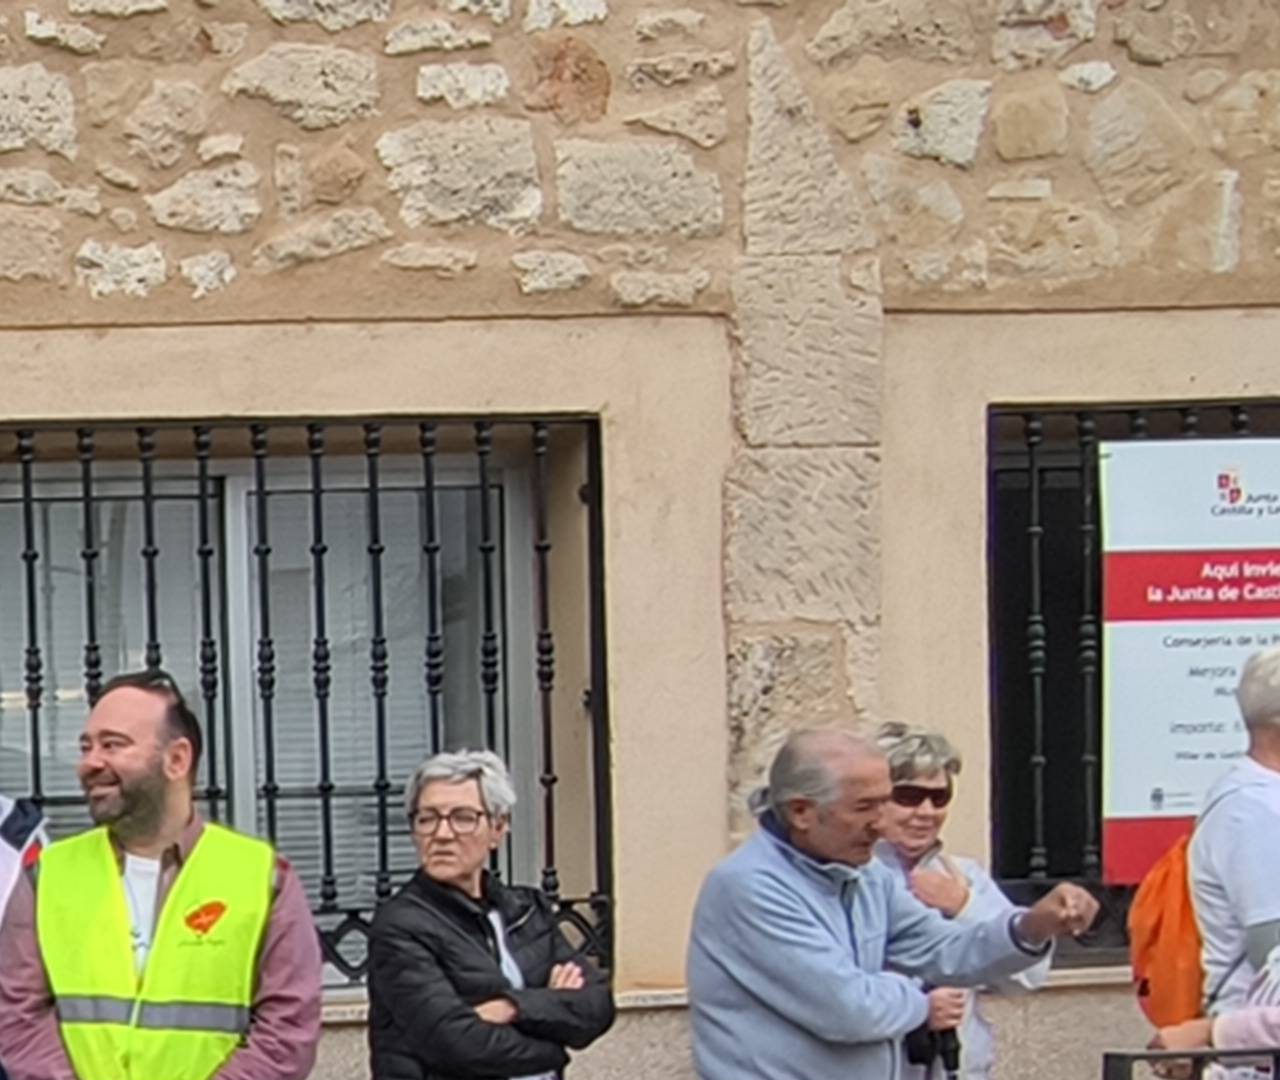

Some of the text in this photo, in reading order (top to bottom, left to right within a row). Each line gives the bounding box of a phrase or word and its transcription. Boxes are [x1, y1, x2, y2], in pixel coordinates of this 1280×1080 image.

[1210, 504, 1254, 517] Castilla
[1257, 506, 1265, 519] y
[1146, 585, 1163, 602] la
[1166, 584, 1214, 601] Junta
[1217, 583, 1240, 600] de
